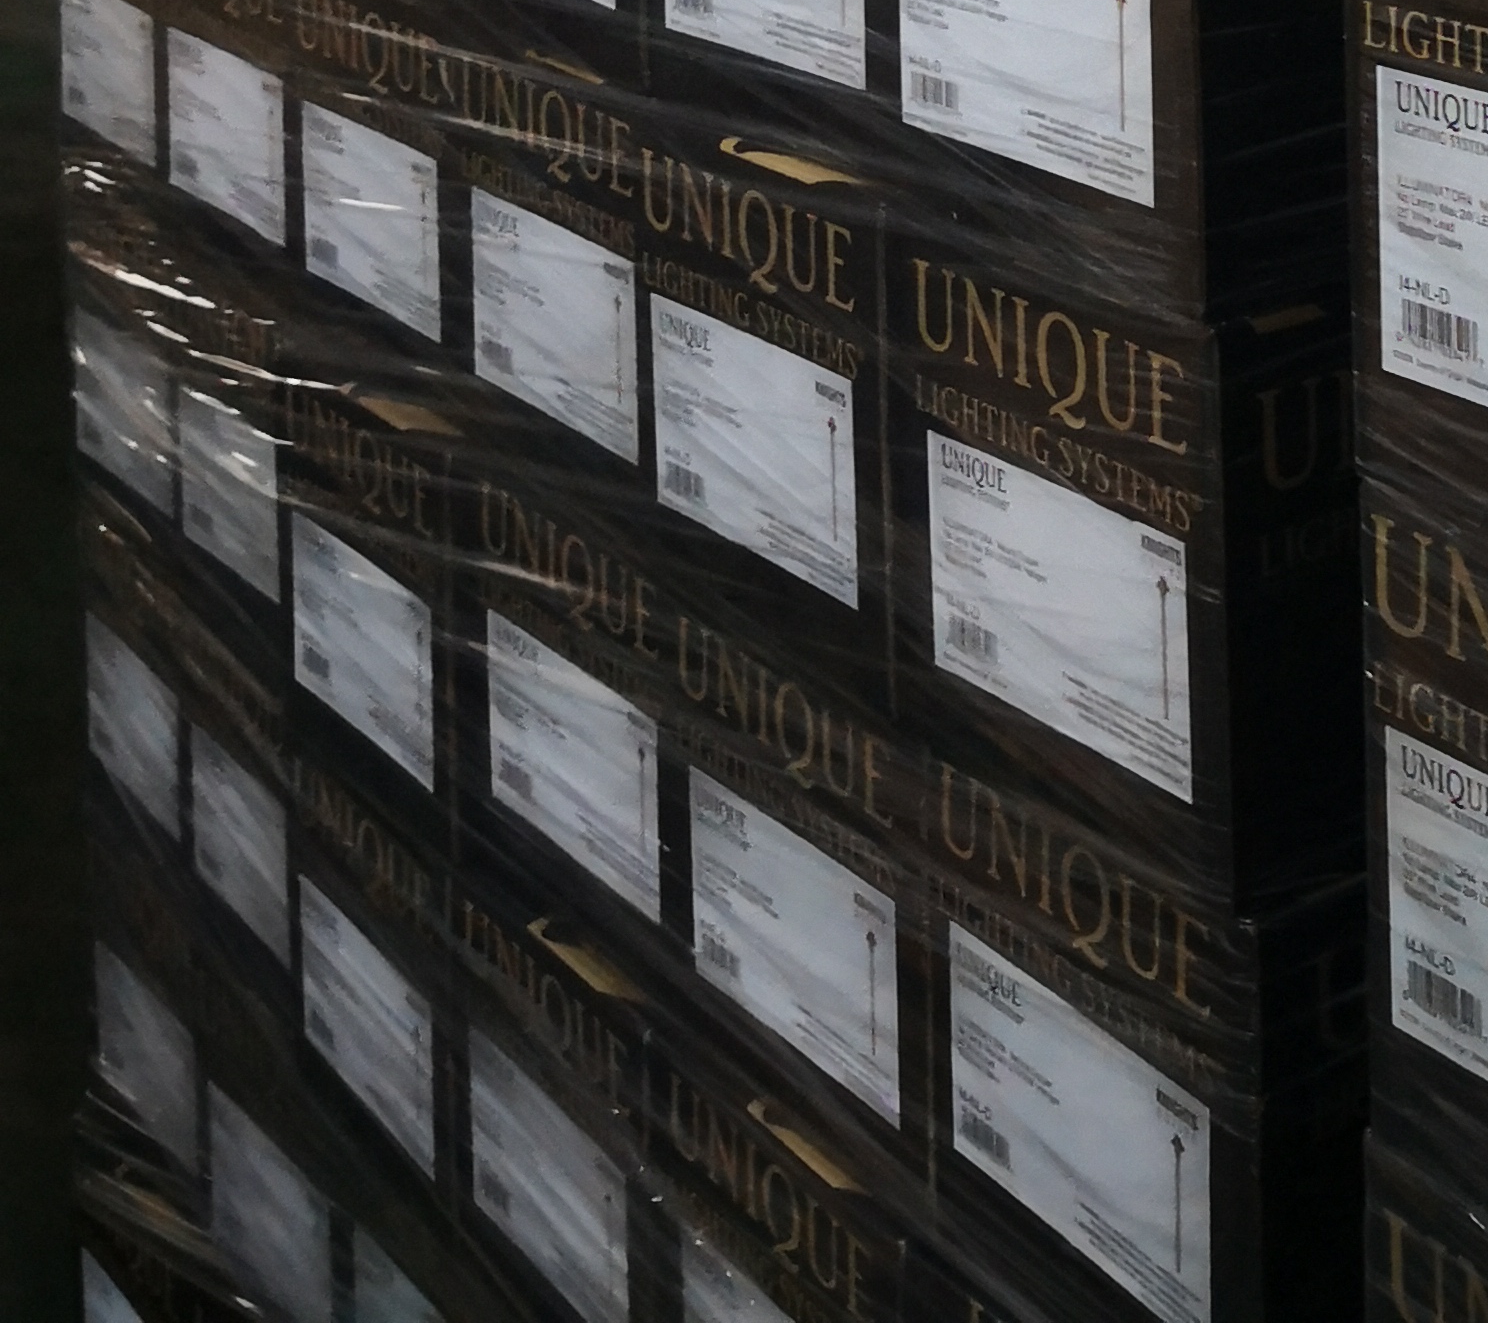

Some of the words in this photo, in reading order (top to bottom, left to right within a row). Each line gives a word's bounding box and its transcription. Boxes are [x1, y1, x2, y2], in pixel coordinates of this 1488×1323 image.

[642, 146, 855, 313] UNIQUE
[642, 251, 751, 328] LIGHTING
[913, 258, 1188, 454] UNIQUE
[914, 374, 1050, 466] LIGHTING
[941, 442, 1009, 495] UNIQUE
[480, 482, 658, 660] UNIQUE
[679, 616, 893, 829] UNIQUE
[942, 762, 1212, 1017] UNIQUE
